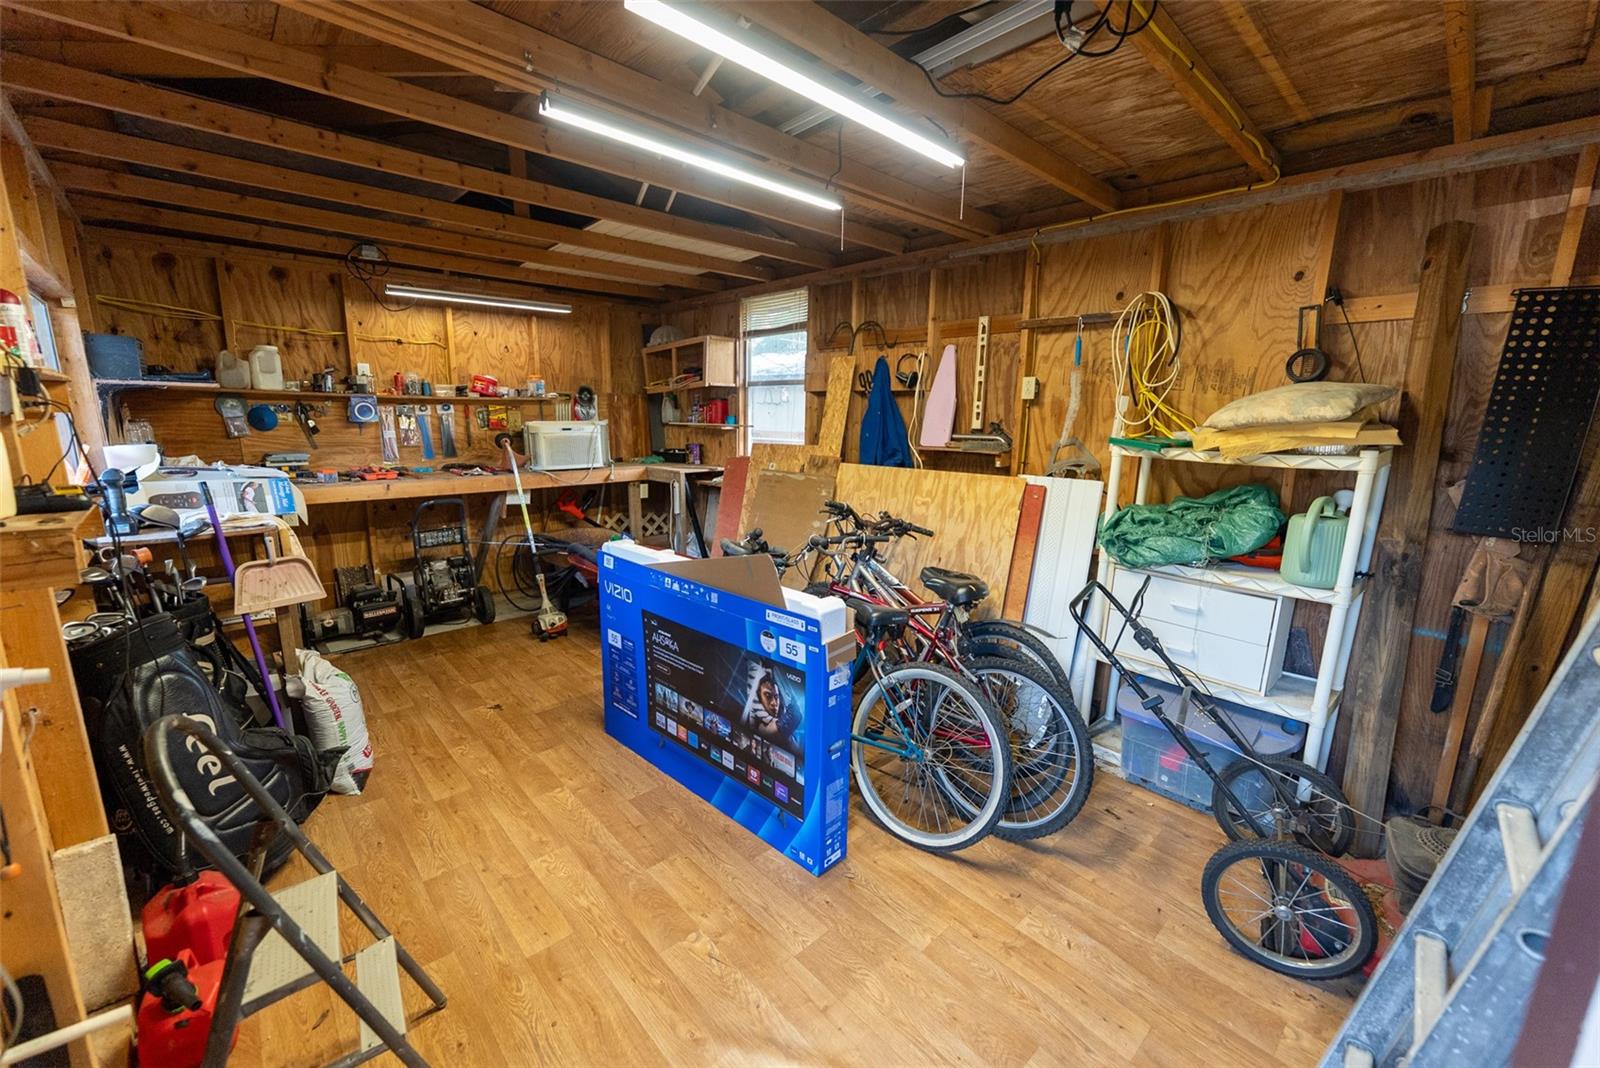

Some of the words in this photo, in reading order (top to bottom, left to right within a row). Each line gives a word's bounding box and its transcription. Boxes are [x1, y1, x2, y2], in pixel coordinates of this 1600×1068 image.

[604, 579, 633, 603] VIZIO
[785, 643, 799, 657] 55
[786, 672, 802, 683] VIZIO
